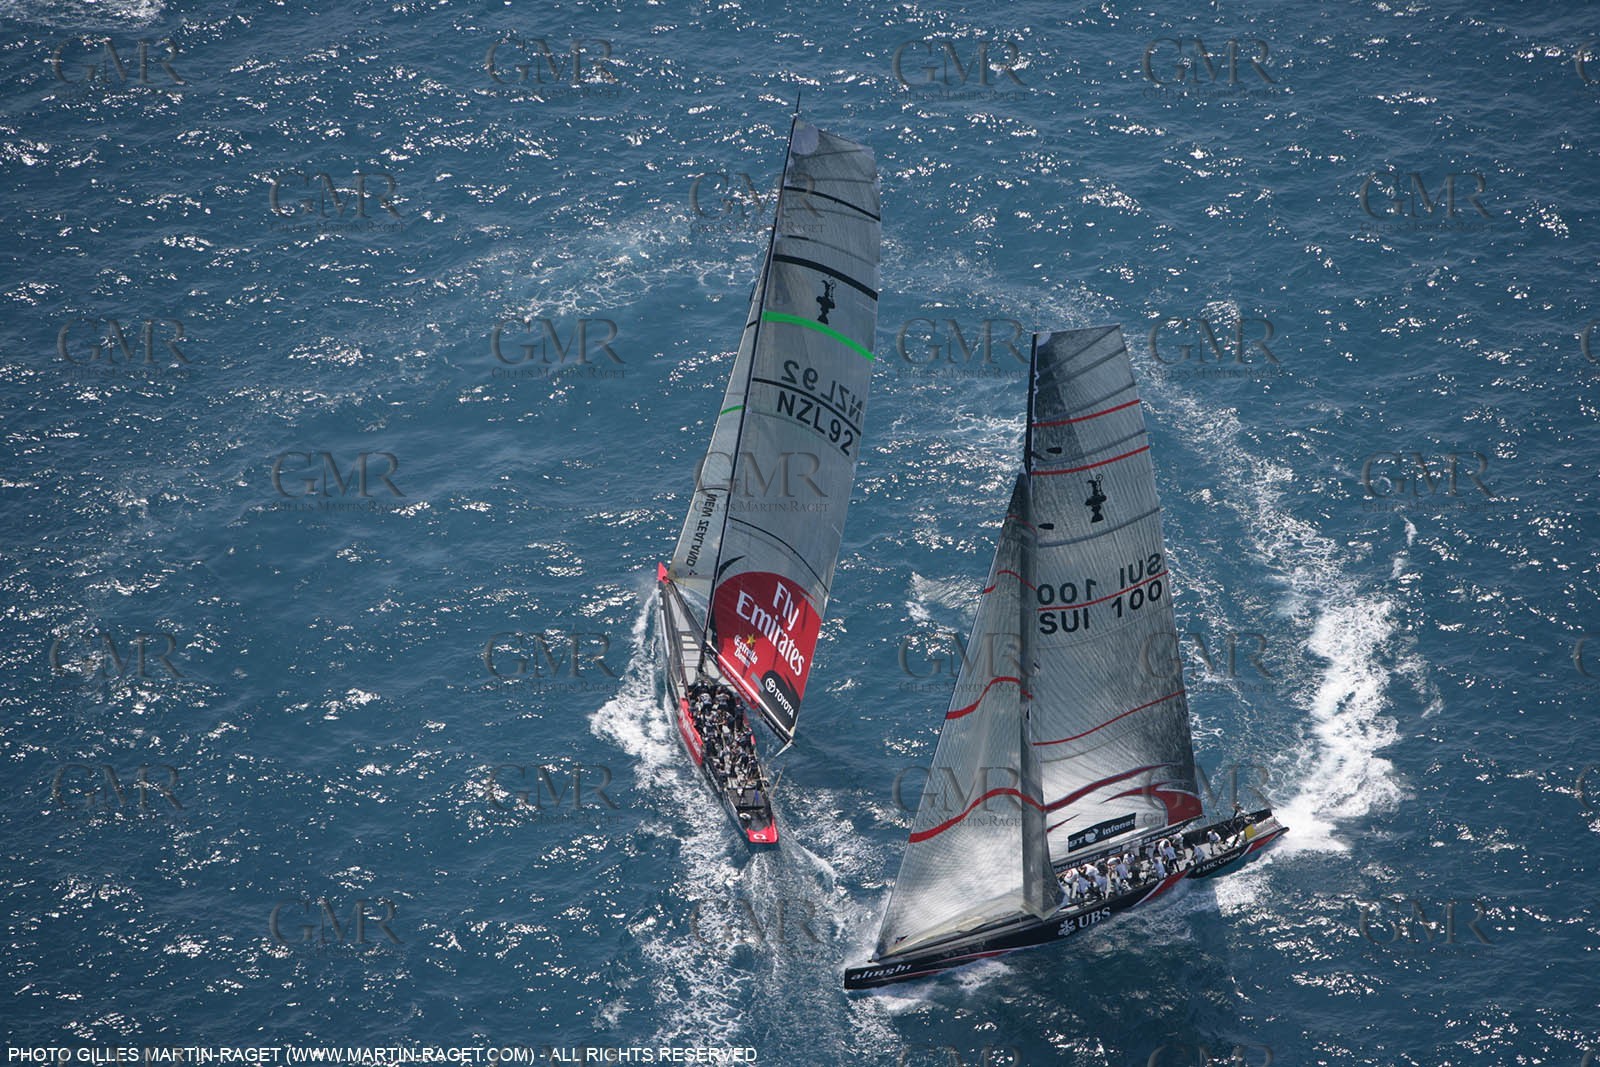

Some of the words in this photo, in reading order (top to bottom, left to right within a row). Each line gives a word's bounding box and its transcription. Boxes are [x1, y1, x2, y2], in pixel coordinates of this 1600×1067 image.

[773, 581, 799, 631] Fly
[1040, 608, 1089, 634] SUI
[1112, 580, 1162, 618] 100
[736, 589, 805, 676] Emirates
[774, 688, 795, 718] TOYOTA
[1102, 818, 1135, 836] infonet
[1078, 907, 1110, 928] UBS
